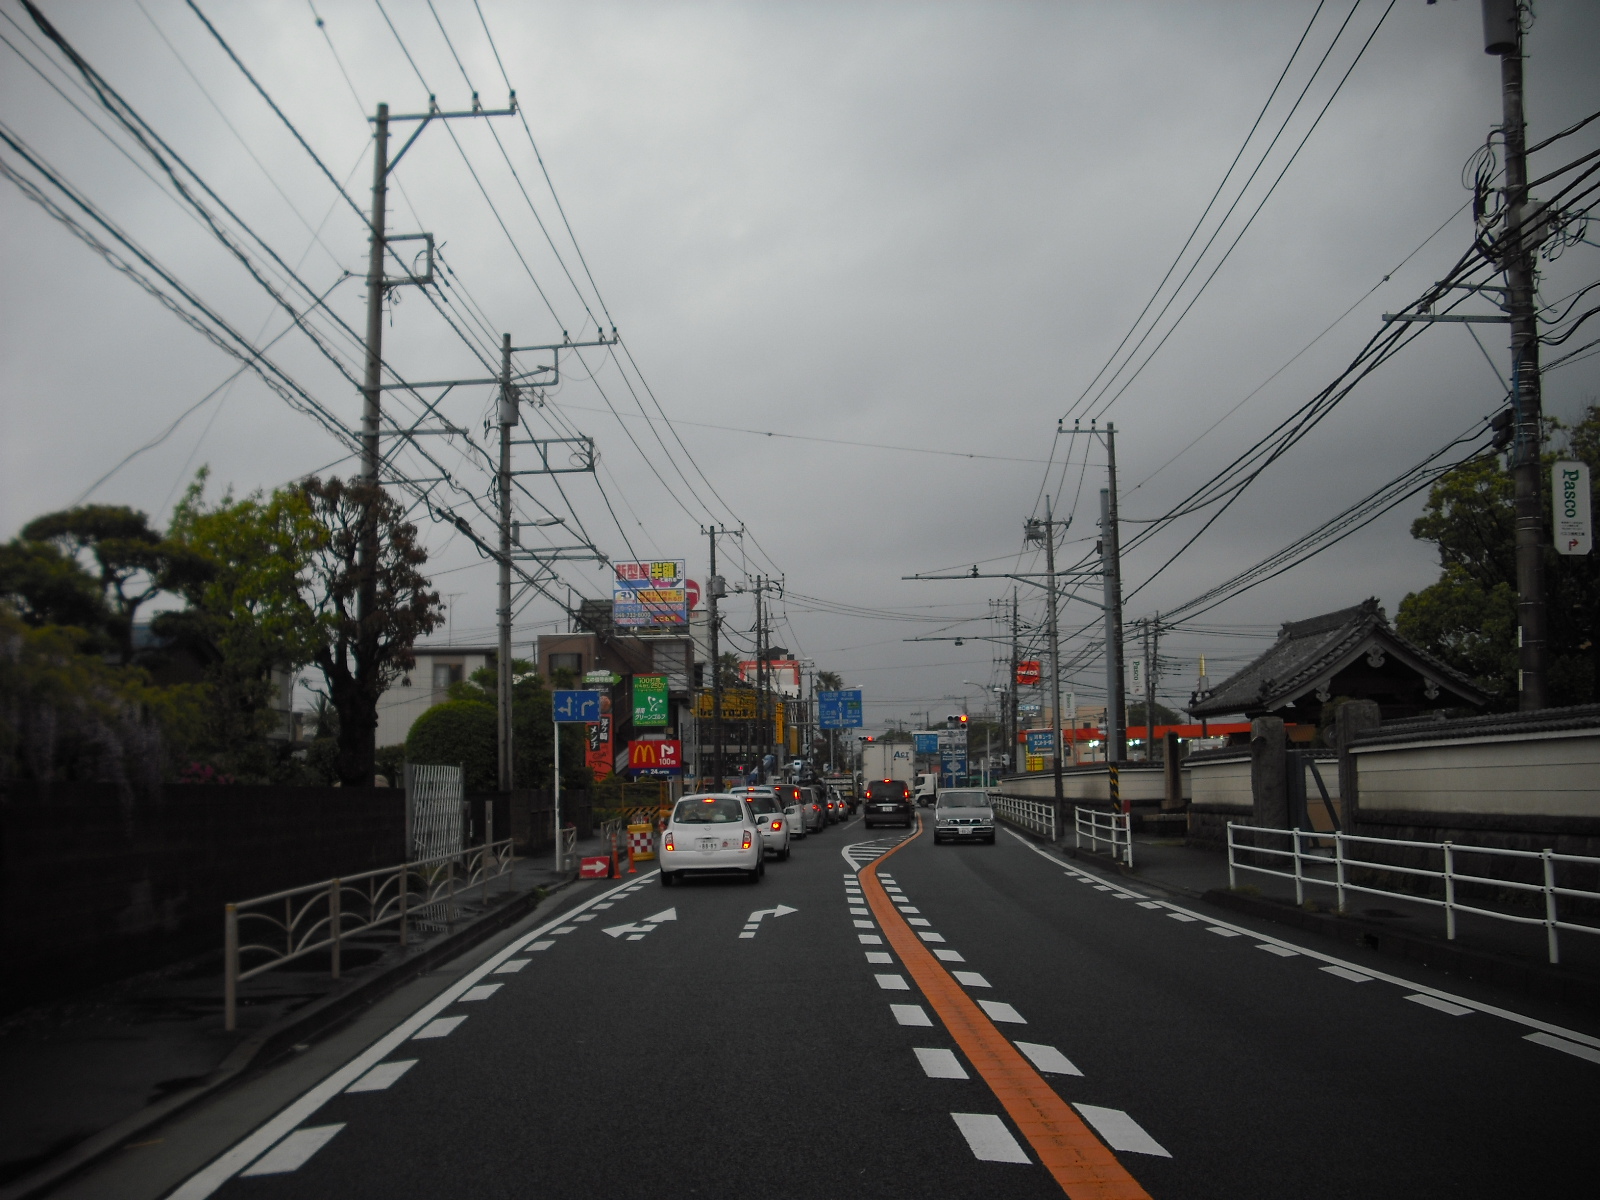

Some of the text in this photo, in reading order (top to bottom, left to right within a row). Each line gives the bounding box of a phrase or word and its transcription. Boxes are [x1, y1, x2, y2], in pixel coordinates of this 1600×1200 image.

[1562, 469, 1579, 518] Pasco
[590, 726, 598, 750] メンチ
